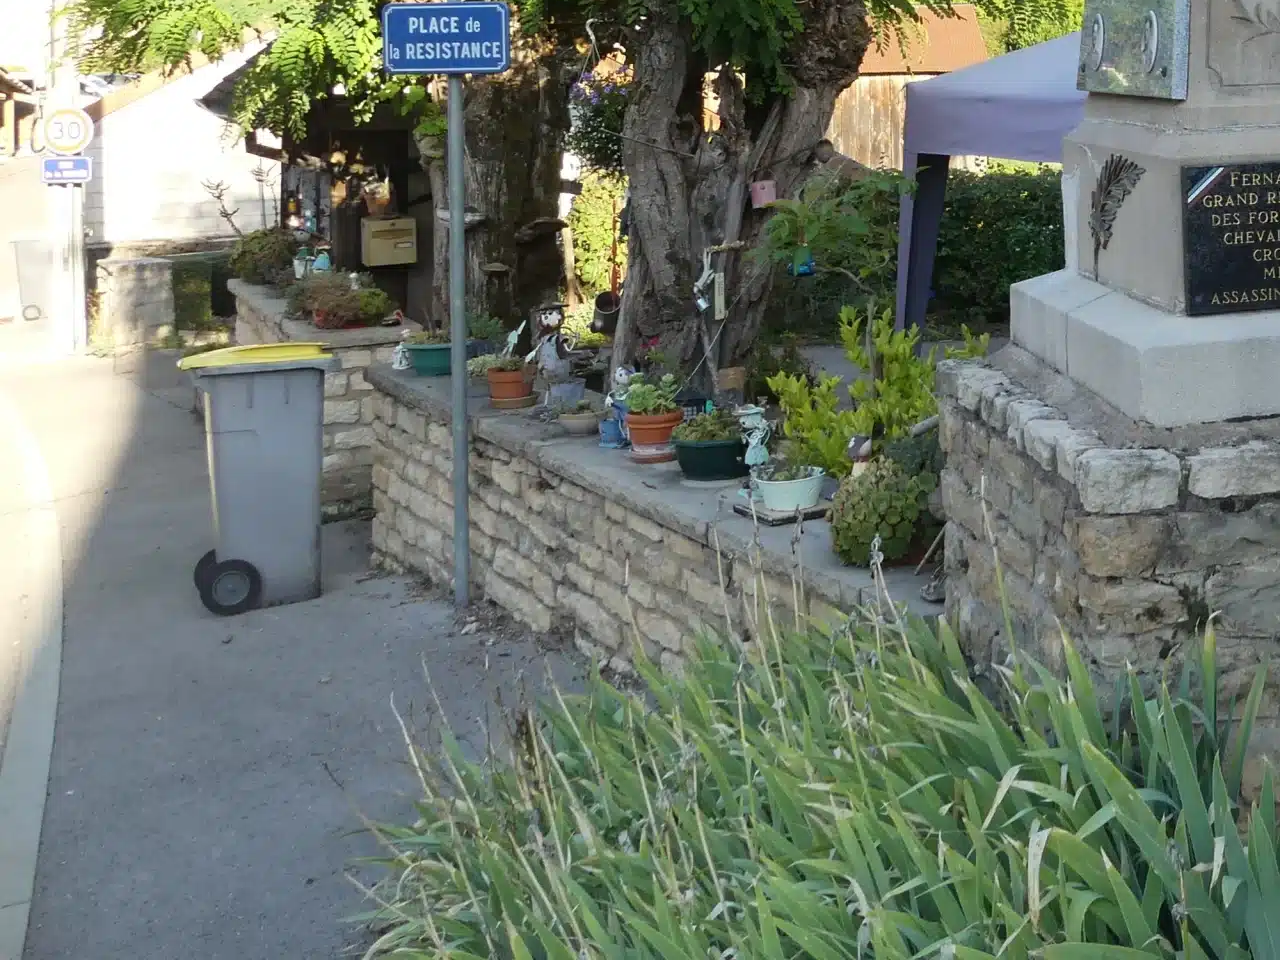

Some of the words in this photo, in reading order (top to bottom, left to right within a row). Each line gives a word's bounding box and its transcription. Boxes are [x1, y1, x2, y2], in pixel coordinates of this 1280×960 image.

[408, 17, 460, 34] PLACE
[465, 17, 481, 33] de
[389, 43, 401, 60] la
[406, 41, 501, 60] RESISTANCE
[53, 122, 81, 140] 30
[1203, 192, 1259, 208] GRAND
[1212, 212, 1240, 227] DES
